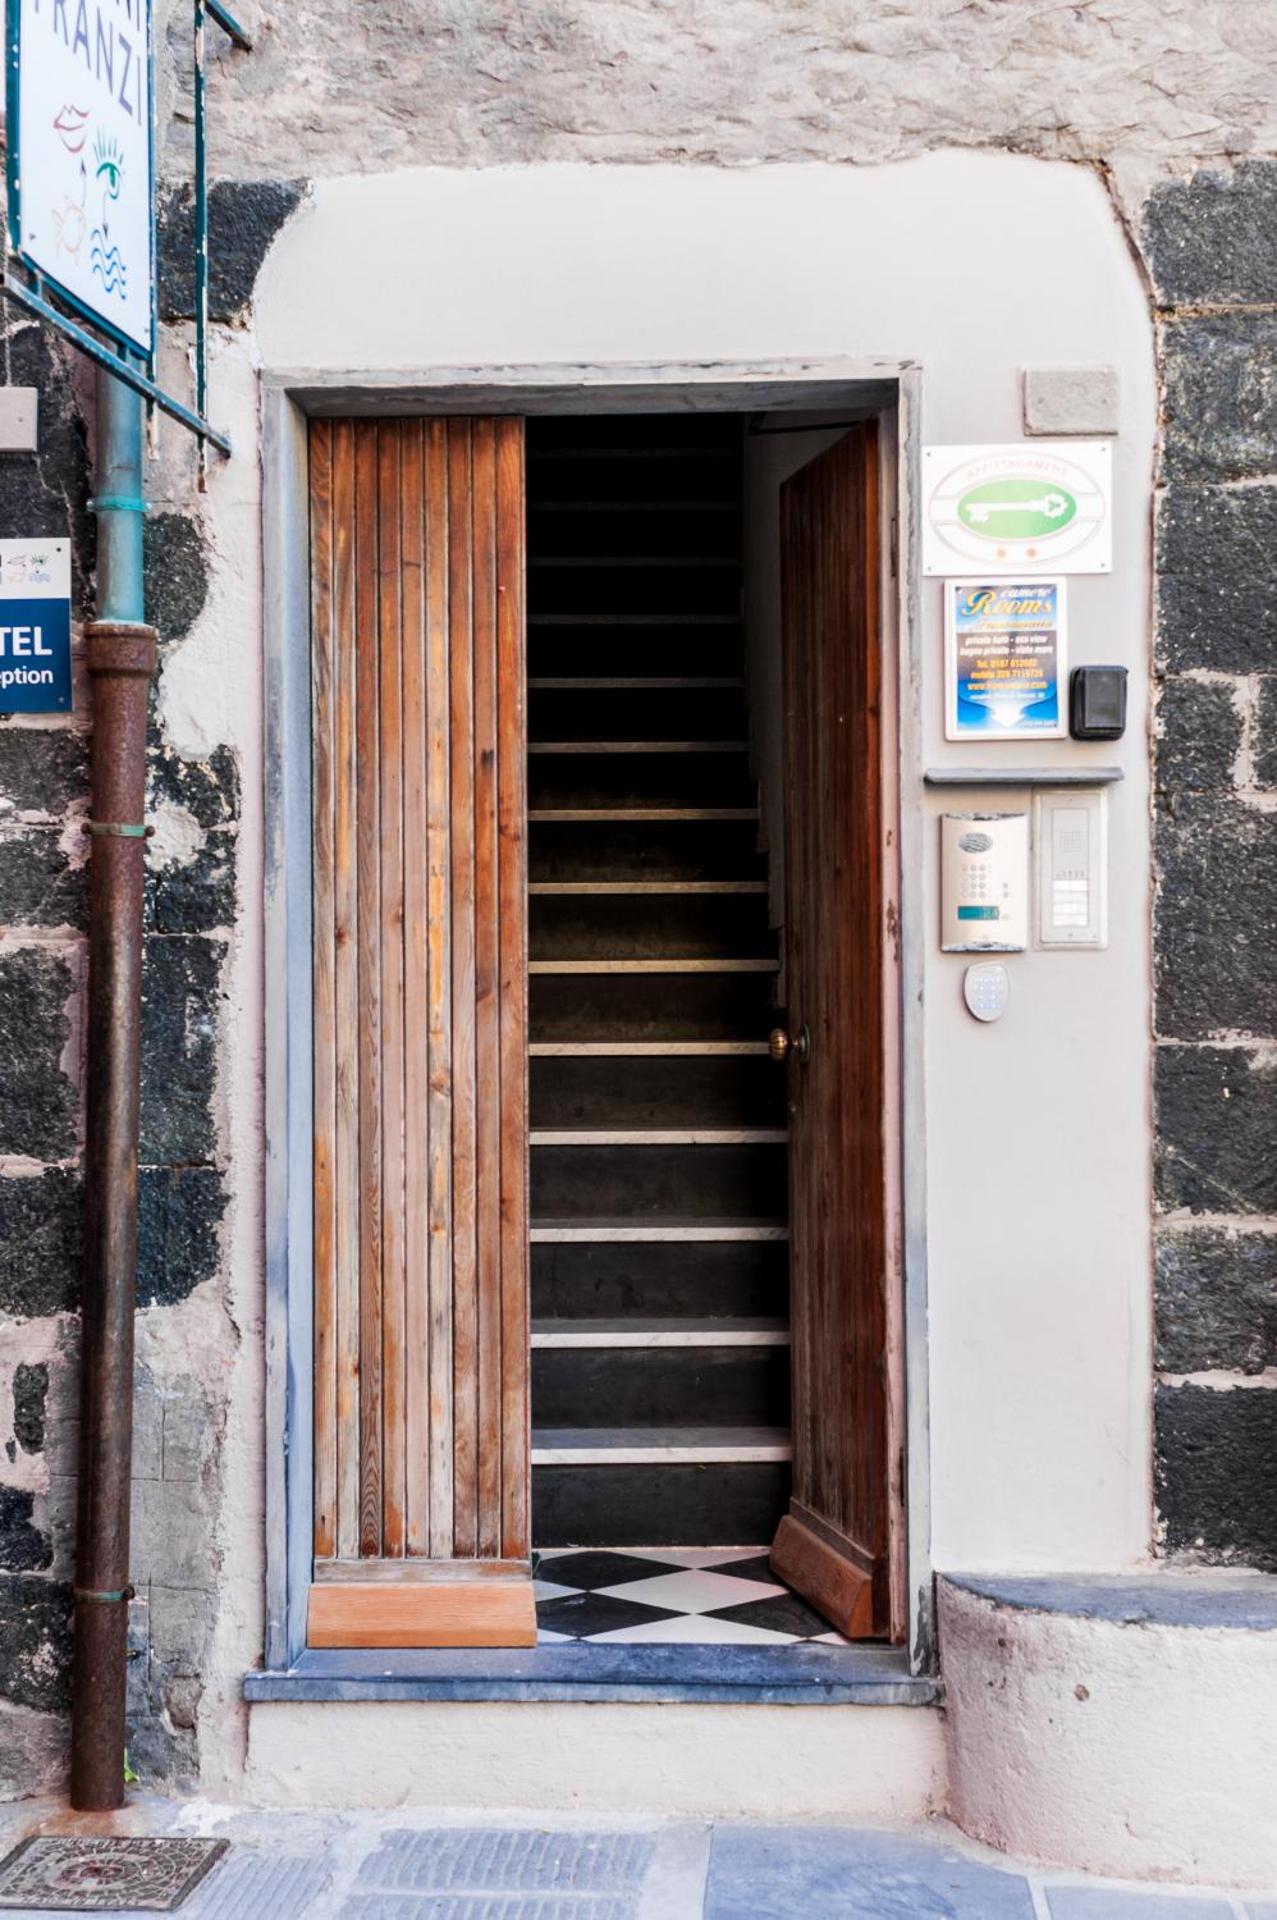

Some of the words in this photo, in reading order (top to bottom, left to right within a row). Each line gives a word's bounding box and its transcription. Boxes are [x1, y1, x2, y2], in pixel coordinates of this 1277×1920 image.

[35, 0, 141, 126] RANZI
[961, 590, 1052, 616] Rooms
[0, 666, 54, 689] ption
